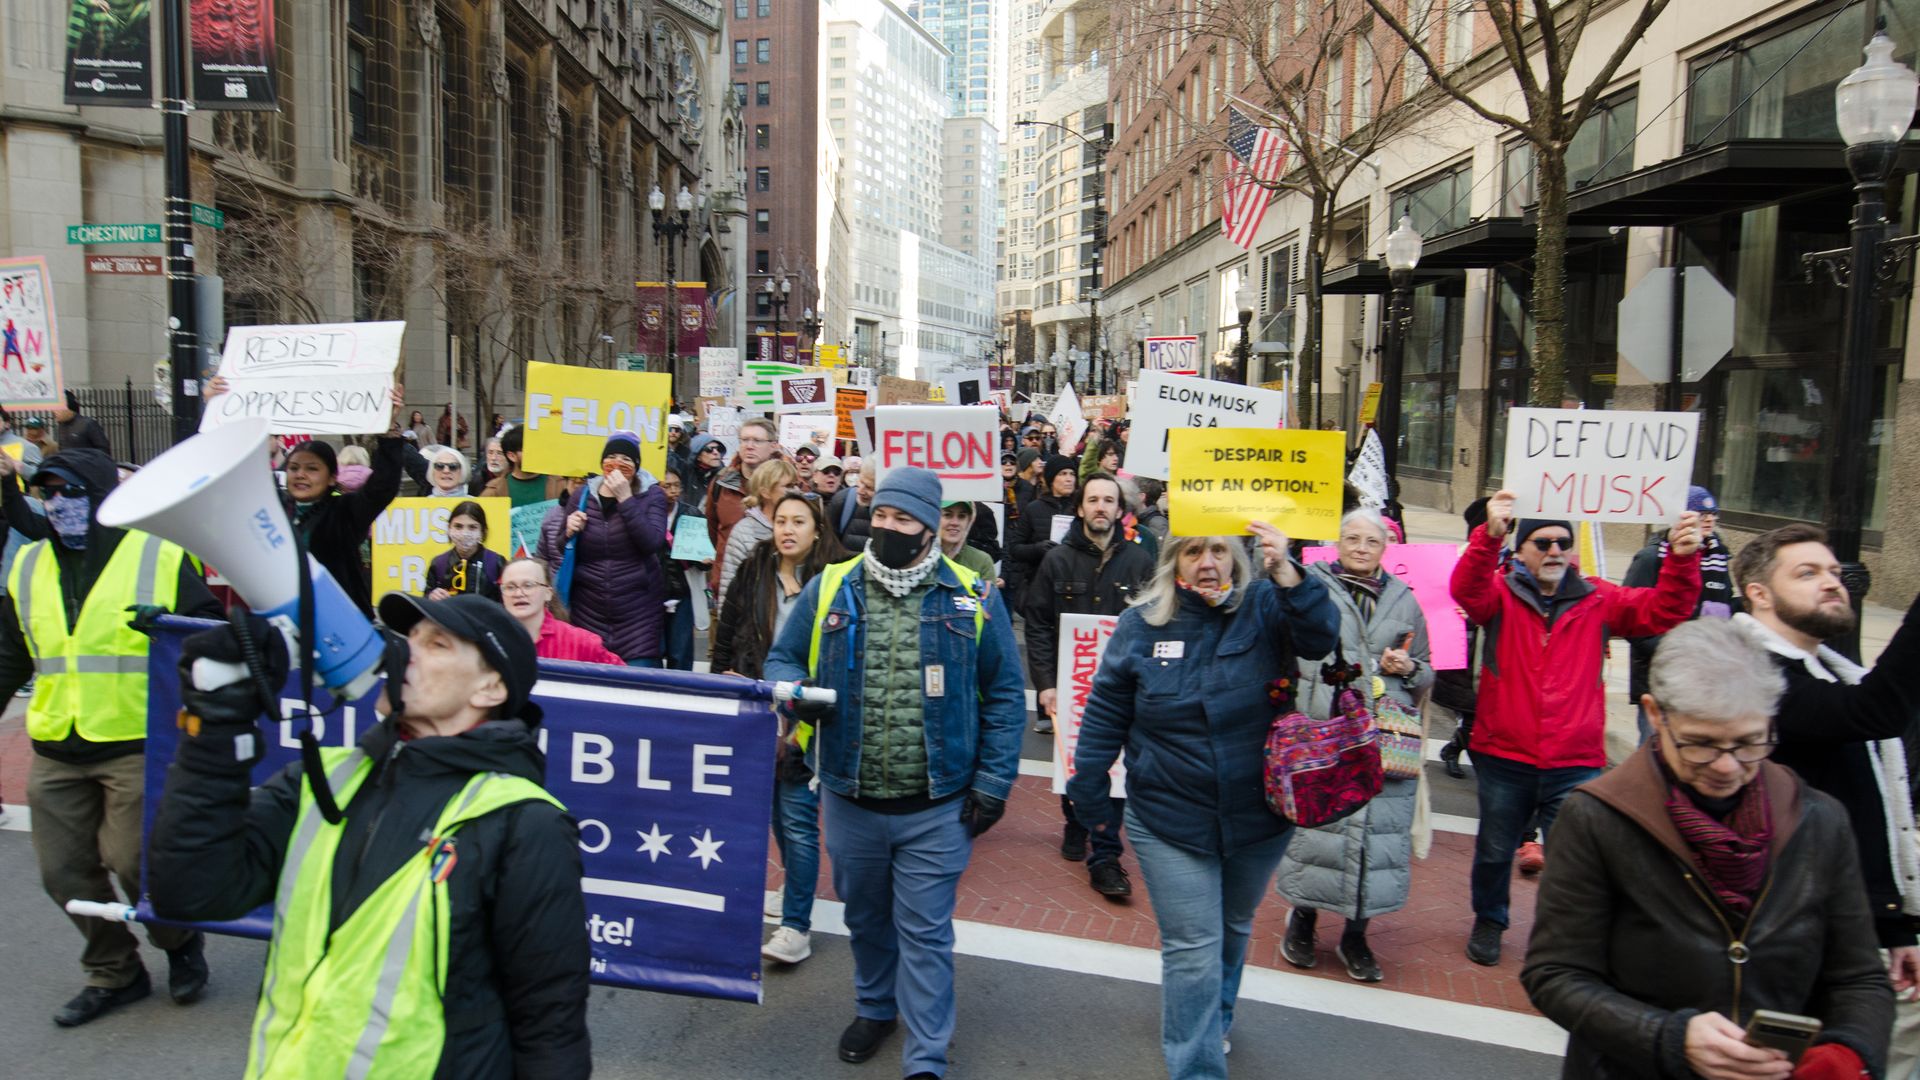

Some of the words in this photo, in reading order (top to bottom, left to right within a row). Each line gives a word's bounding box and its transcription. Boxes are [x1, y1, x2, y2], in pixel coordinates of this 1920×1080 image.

[194, 205, 215, 224] RUSH
[77, 225, 145, 242] CHESTNUT
[116, 262, 144, 273] DITKA
[244, 333, 345, 365] RESIST
[1149, 341, 1197, 370] RESIST
[222, 386, 386, 417] OPPRESSION
[1158, 385, 1204, 406] ELON
[1208, 393, 1258, 415] MUSK
[1187, 413, 1202, 428] IS
[883, 430, 994, 469] FELON
[1526, 417, 1688, 461] DEFUND
[1291, 450, 1307, 464] IS
[1181, 478, 1213, 492] NOT
[1221, 478, 1245, 492] AN
[1536, 472, 1666, 516] MUSK
[1201, 506, 1234, 514] Senator
[1236, 506, 1263, 514] Bernie
[254, 508, 286, 549] PYLE
[376, 507, 452, 545] MUS
